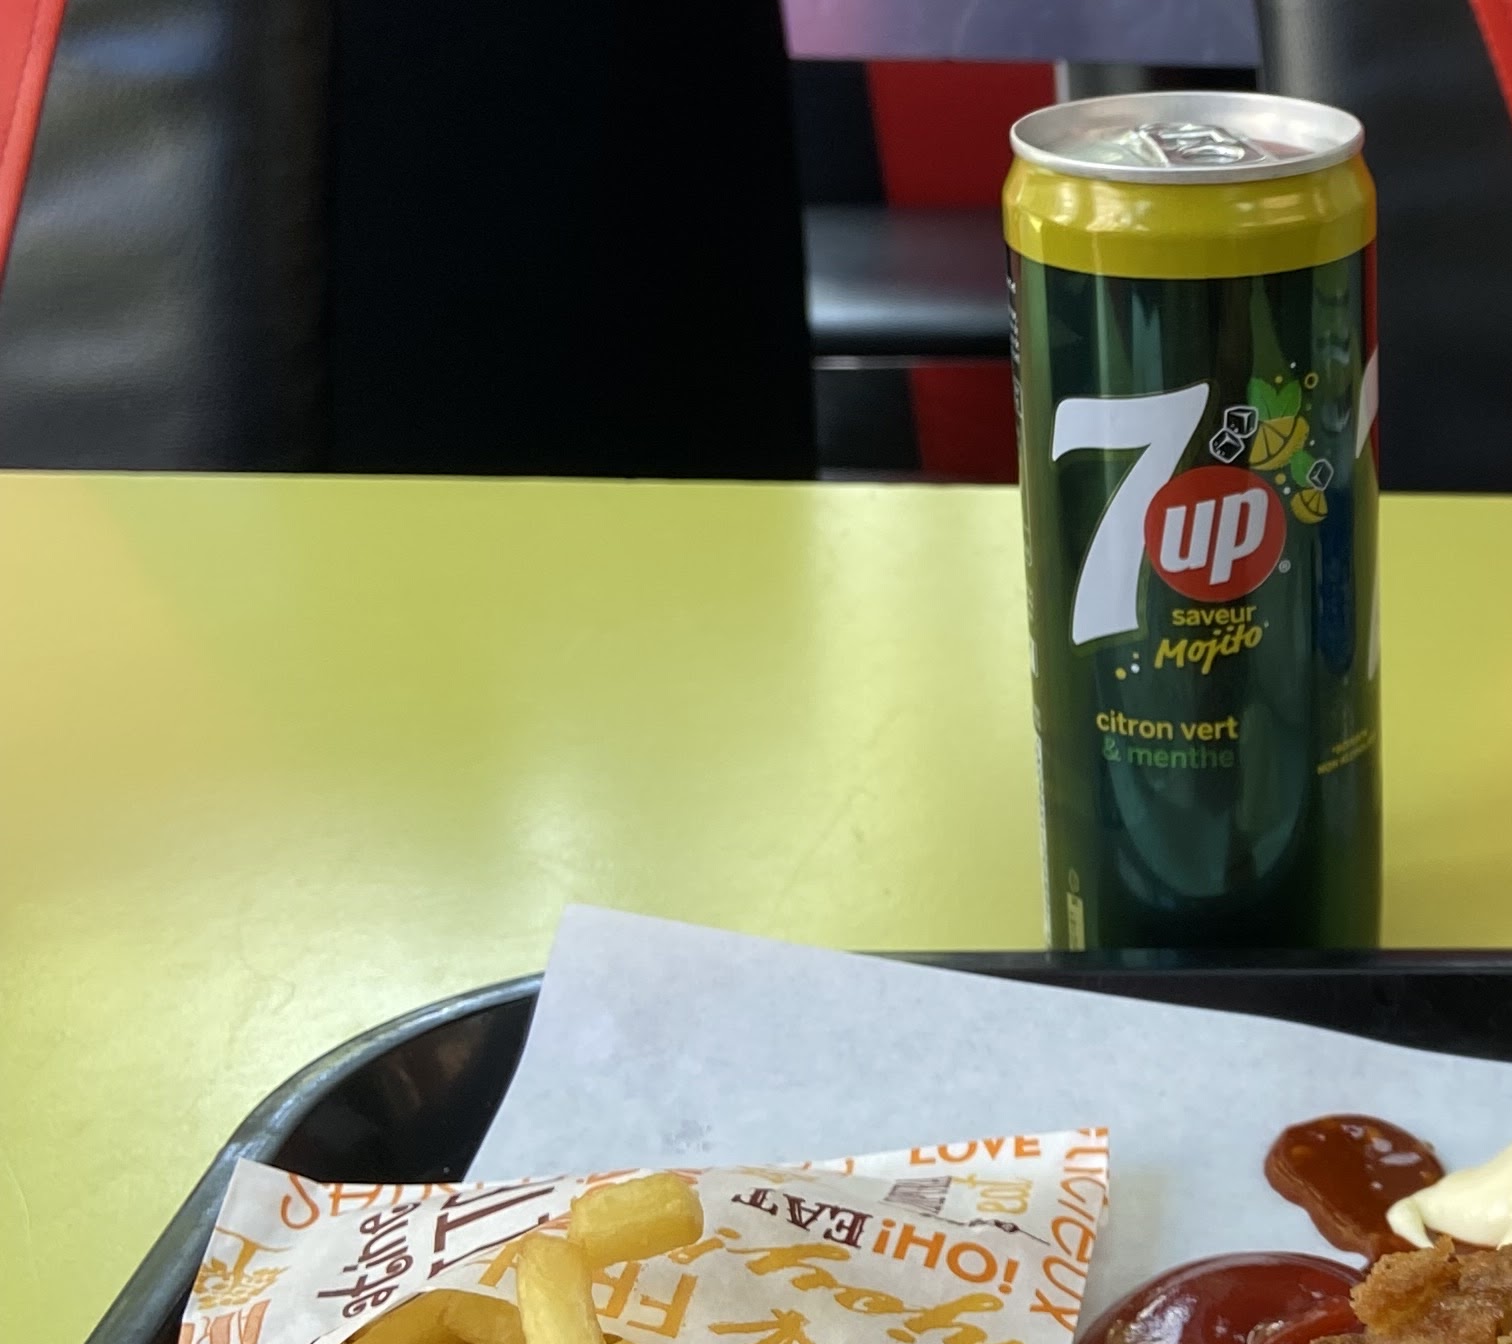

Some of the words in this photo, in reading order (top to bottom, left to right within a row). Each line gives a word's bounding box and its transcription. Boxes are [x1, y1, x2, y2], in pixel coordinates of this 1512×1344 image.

[1172, 606, 1257, 626] saveur
[1154, 624, 1263, 675] Mojito
[1096, 709, 1174, 740] citron
[1181, 715, 1239, 741] vert
[1103, 735, 1121, 762] &
[1127, 745, 1234, 769] menthe
[732, 1187, 874, 1249] EAT
